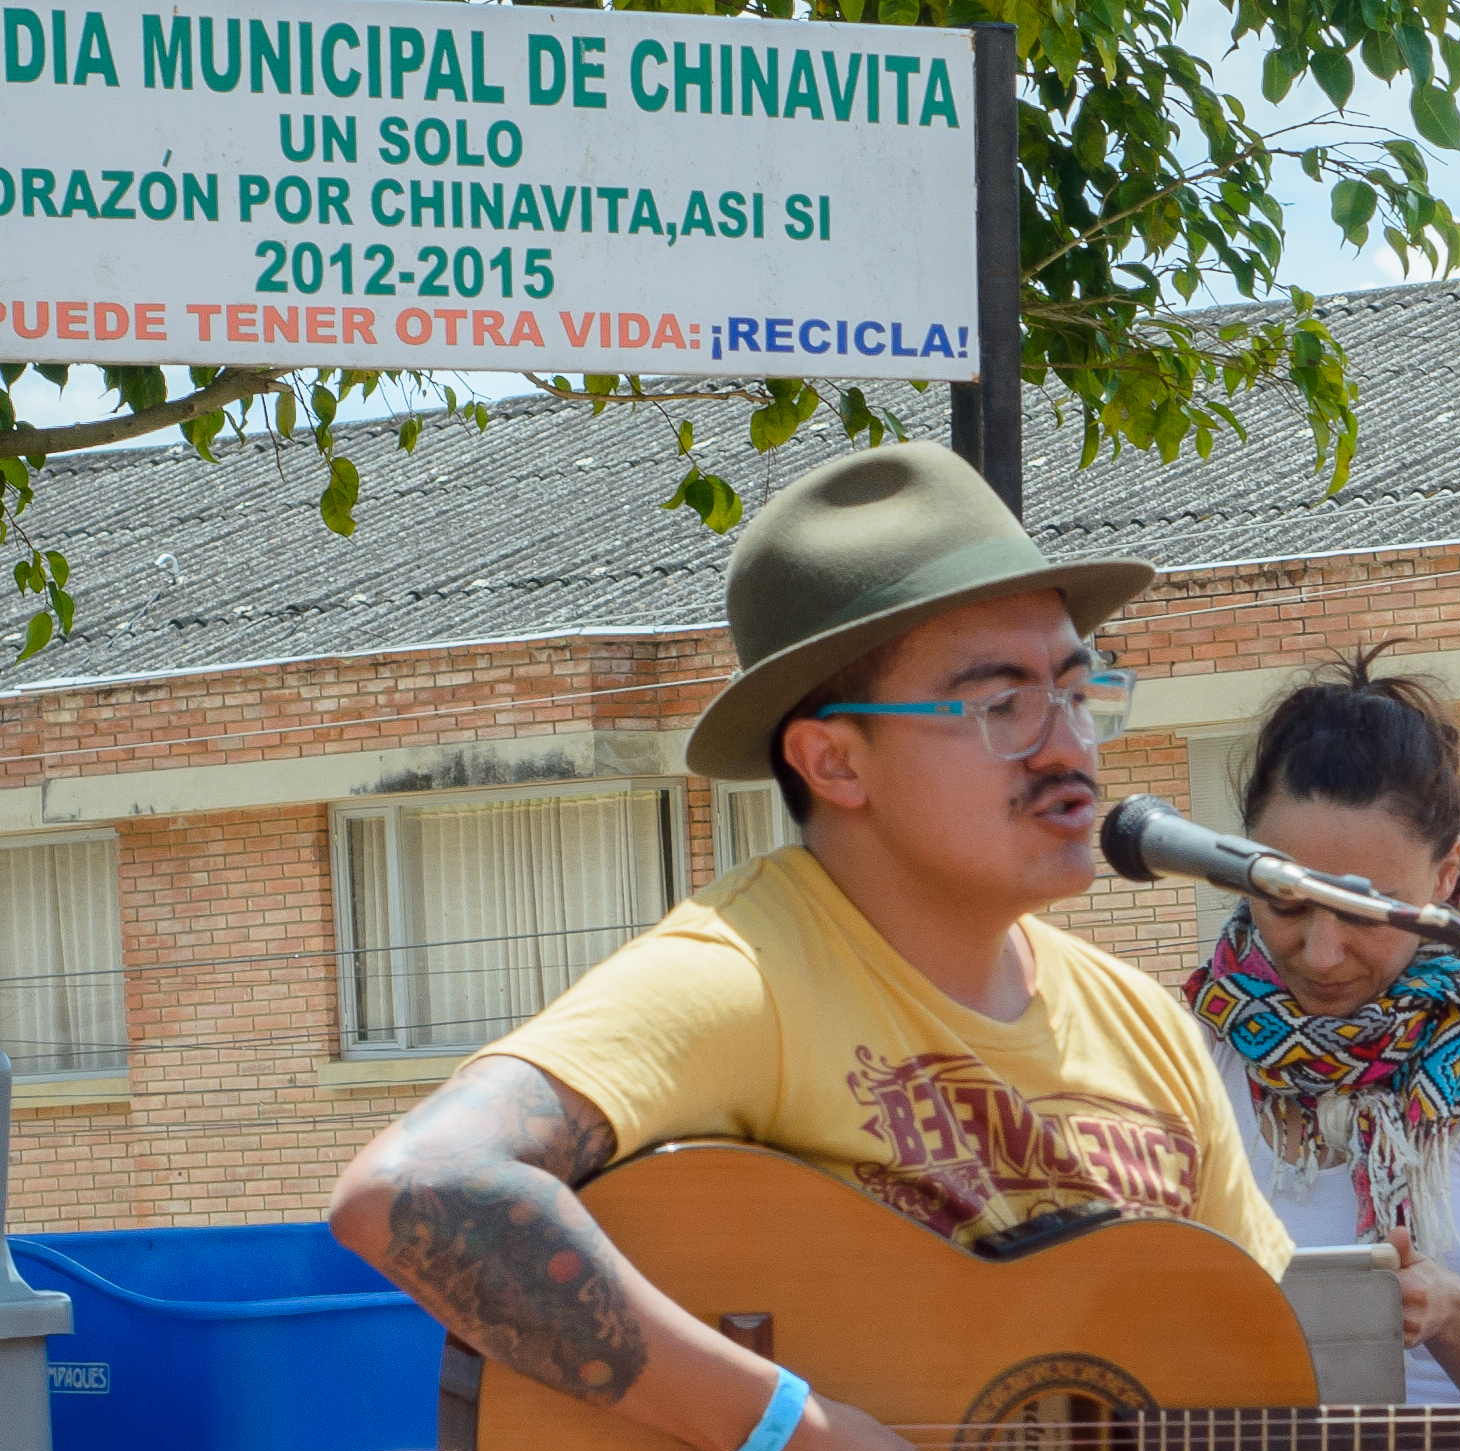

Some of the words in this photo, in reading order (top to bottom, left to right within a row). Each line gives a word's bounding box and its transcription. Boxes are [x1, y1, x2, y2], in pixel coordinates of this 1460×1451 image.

[3, 7, 120, 87] DIA
[142, 13, 505, 104] MUNICIPAL
[528, 34, 607, 109] DE
[630, 39, 960, 129] CHINAVITA
[280, 114, 357, 163] UN
[380, 117, 523, 168] SOLO
[239, 174, 351, 225] POR
[785, 194, 830, 240] SI
[256, 240, 554, 299] 2012-2015
[0, 301, 167, 341] UEDE
[187, 304, 378, 345] TENER
[396, 307, 546, 348] OTRA
